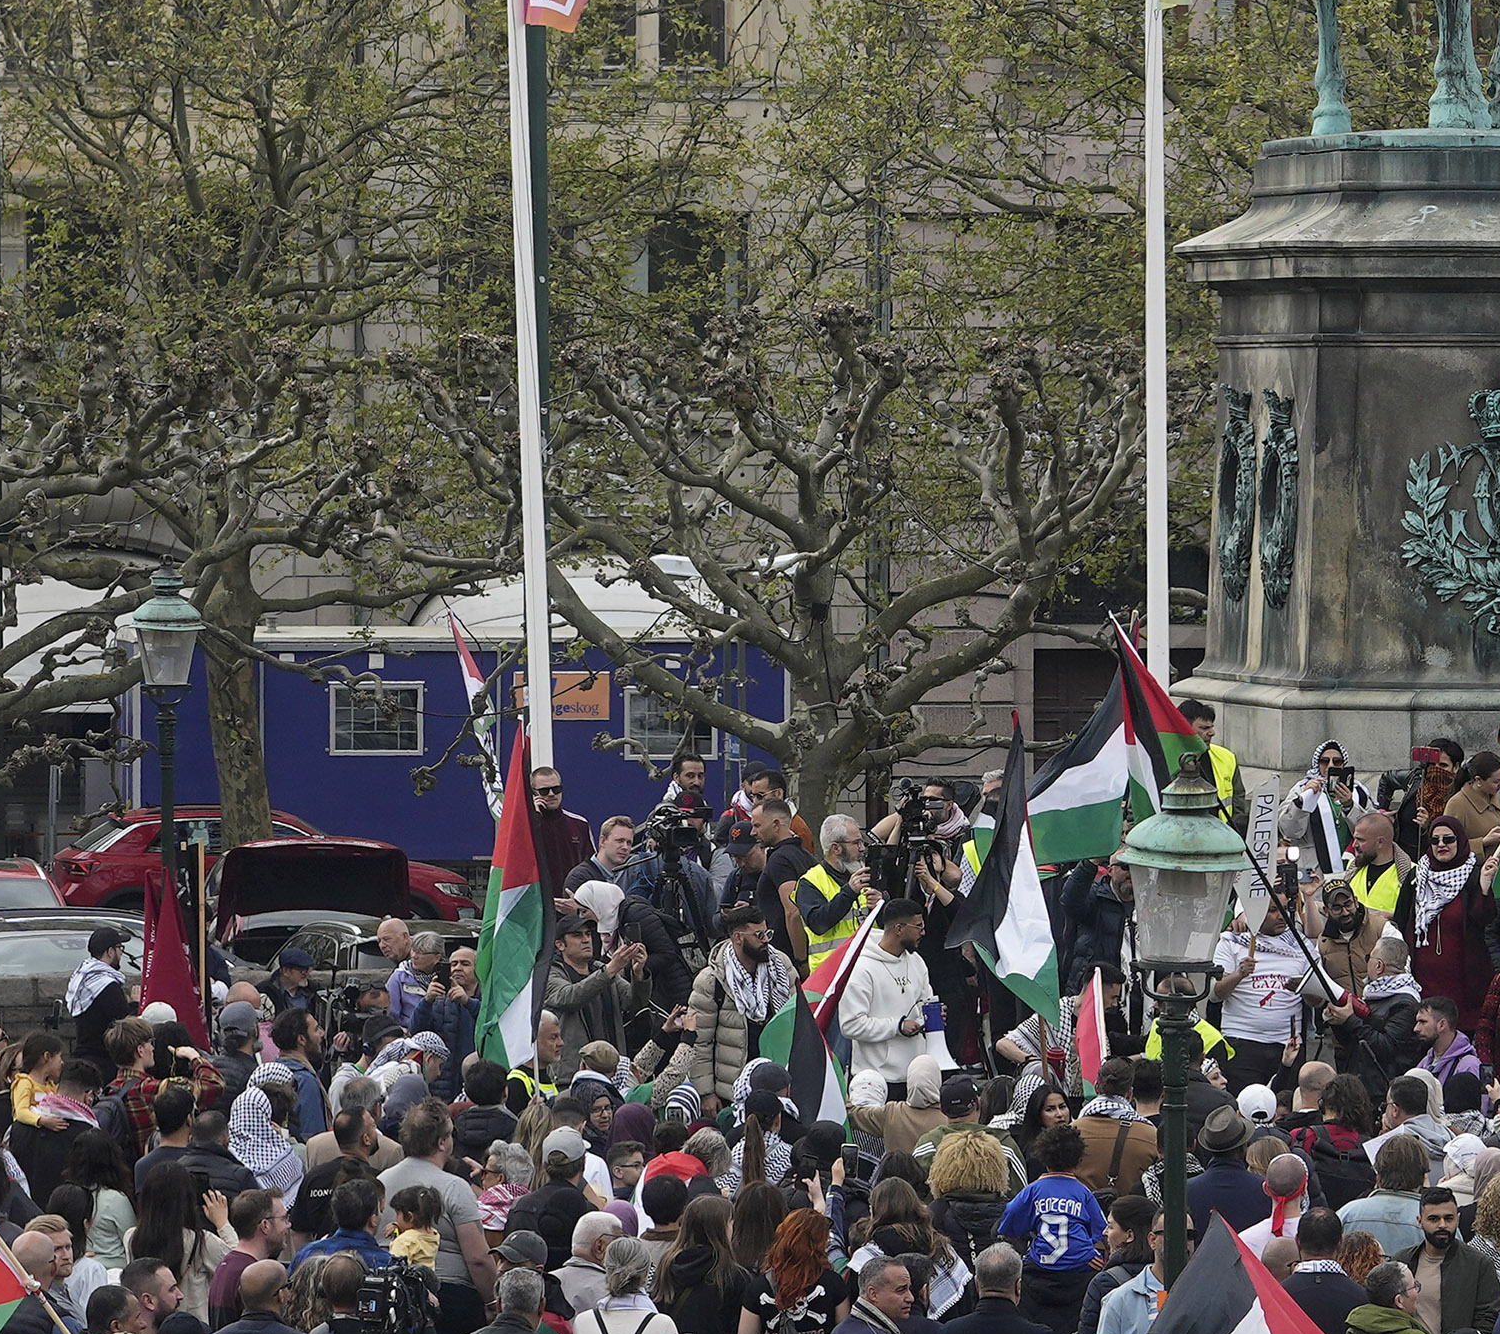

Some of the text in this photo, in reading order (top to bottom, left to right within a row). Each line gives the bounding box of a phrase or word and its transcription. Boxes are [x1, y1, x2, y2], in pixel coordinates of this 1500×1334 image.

[552, 701, 600, 716] geskog
[1249, 793, 1275, 899] PALESTINE
[1034, 1197, 1082, 1217] BENZEMA
[1039, 1214, 1069, 1265] 9
